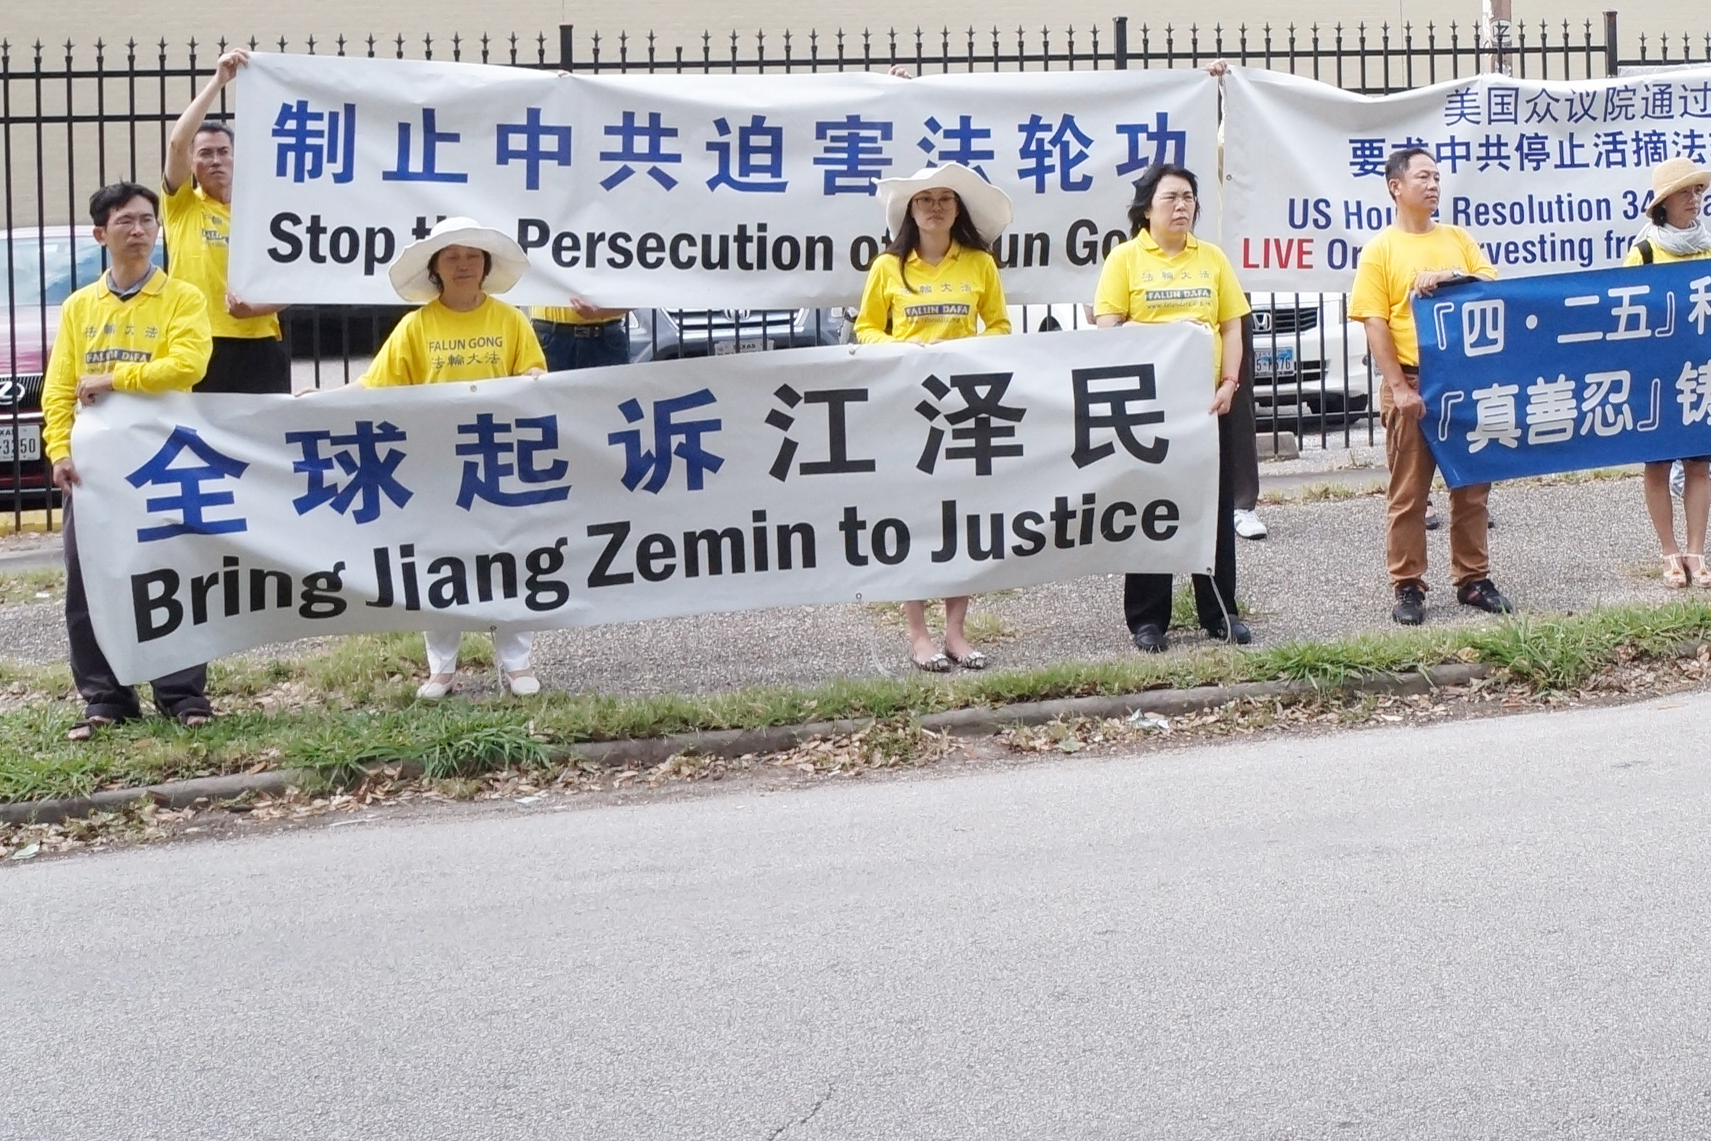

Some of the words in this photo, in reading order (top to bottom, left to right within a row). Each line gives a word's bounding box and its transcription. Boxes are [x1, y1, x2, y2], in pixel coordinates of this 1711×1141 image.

[271, 100, 1187, 197] 制止中共迫害法轮功
[1288, 197, 1332, 230] US
[1452, 191, 1612, 228] Resolution
[1622, 189, 1655, 221] 34
[266, 211, 396, 277] Stop
[516, 217, 832, 272] Persecution
[1065, 218, 1127, 267] Go
[1242, 237, 1315, 270] LIVE
[905, 306, 939, 317] FALUN
[942, 304, 968, 314] DAFA
[1148, 291, 1181, 300] FALUN
[1183, 289, 1209, 298] DAFA
[428, 338, 466, 354] FALUN
[468, 336, 503, 349] GONG
[125, 362, 1170, 543] 全球起诉江泽民
[129, 555, 348, 644] Bring
[364, 536, 571, 613] Jiang
[585, 508, 825, 589] Zemin
[838, 505, 911, 566] to
[931, 491, 1181, 565] Justice
